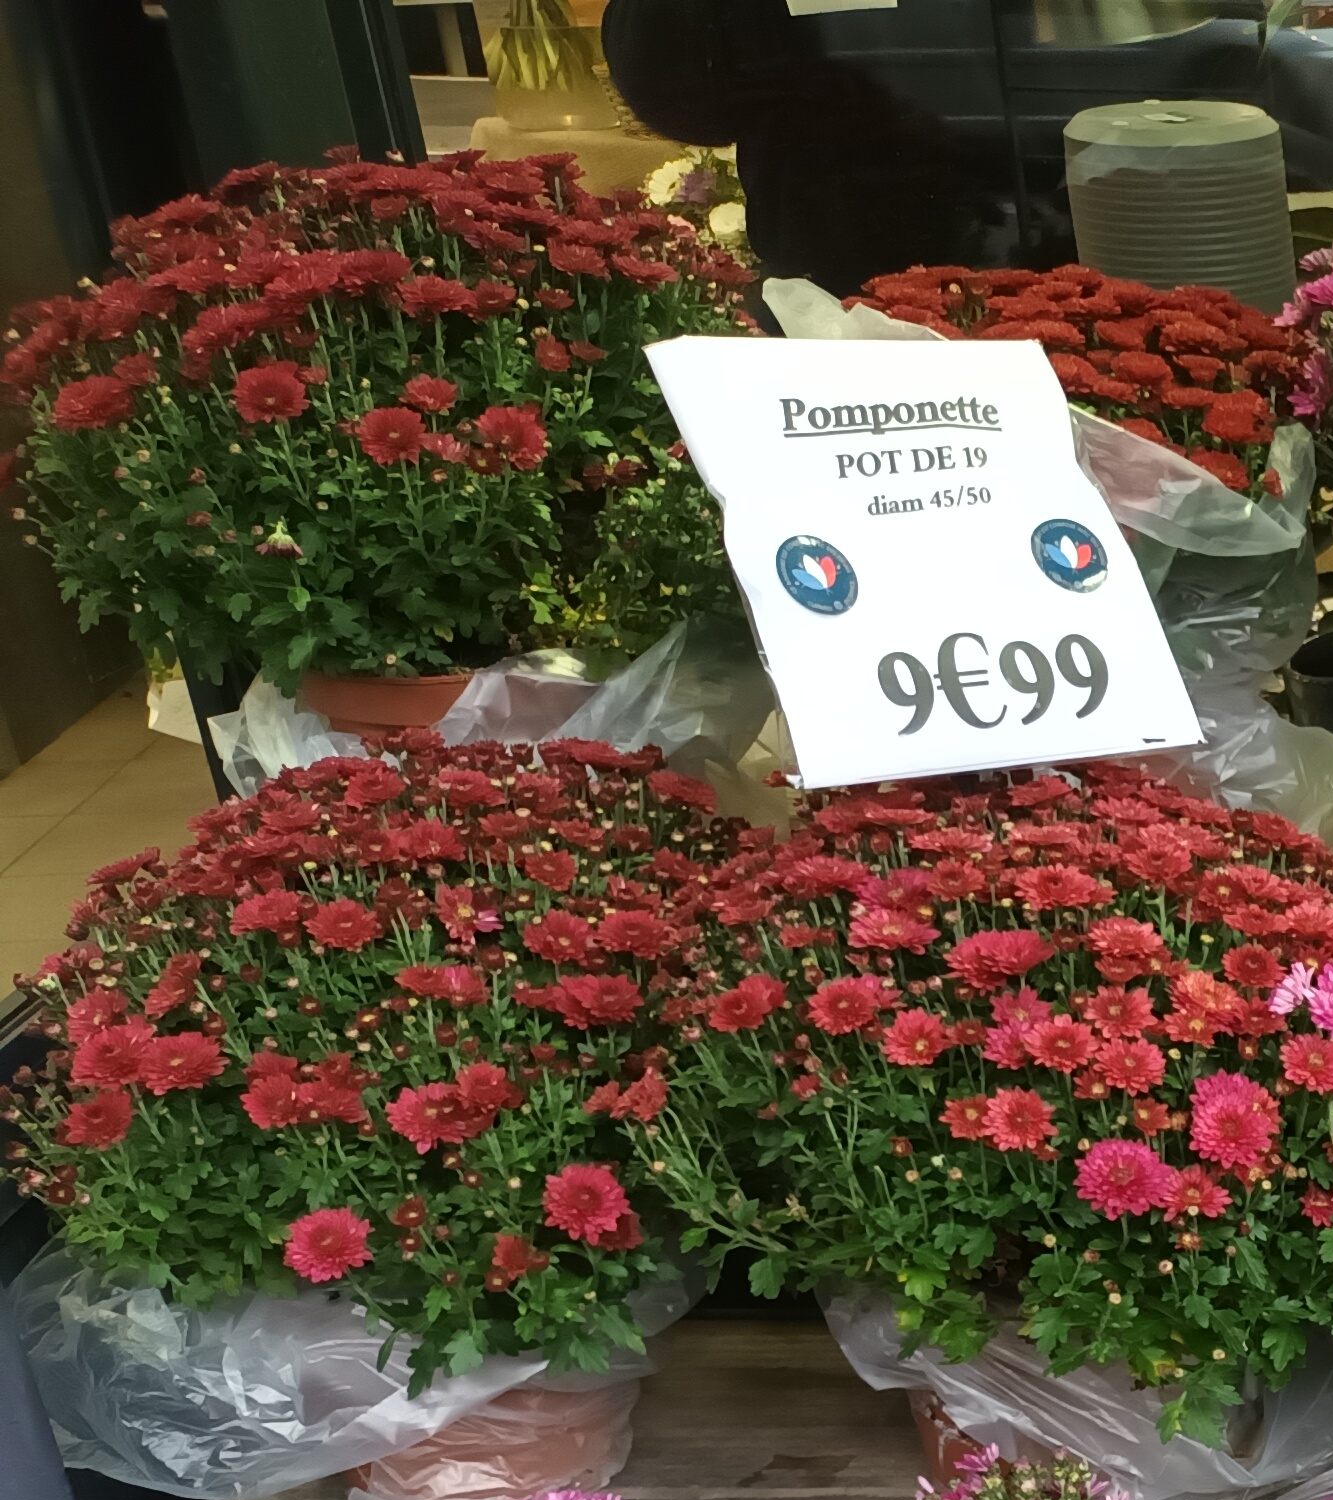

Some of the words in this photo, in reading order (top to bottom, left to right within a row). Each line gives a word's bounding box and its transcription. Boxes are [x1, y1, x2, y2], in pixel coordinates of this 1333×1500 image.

[779, 396, 1000, 435] Pomponette
[836, 451, 902, 479] POT
[912, 447, 956, 472] DE
[965, 446, 988, 469] 19
[867, 493, 924, 516] diam
[929, 486, 992, 510] 45/50
[877, 632, 1109, 736] 9€99
